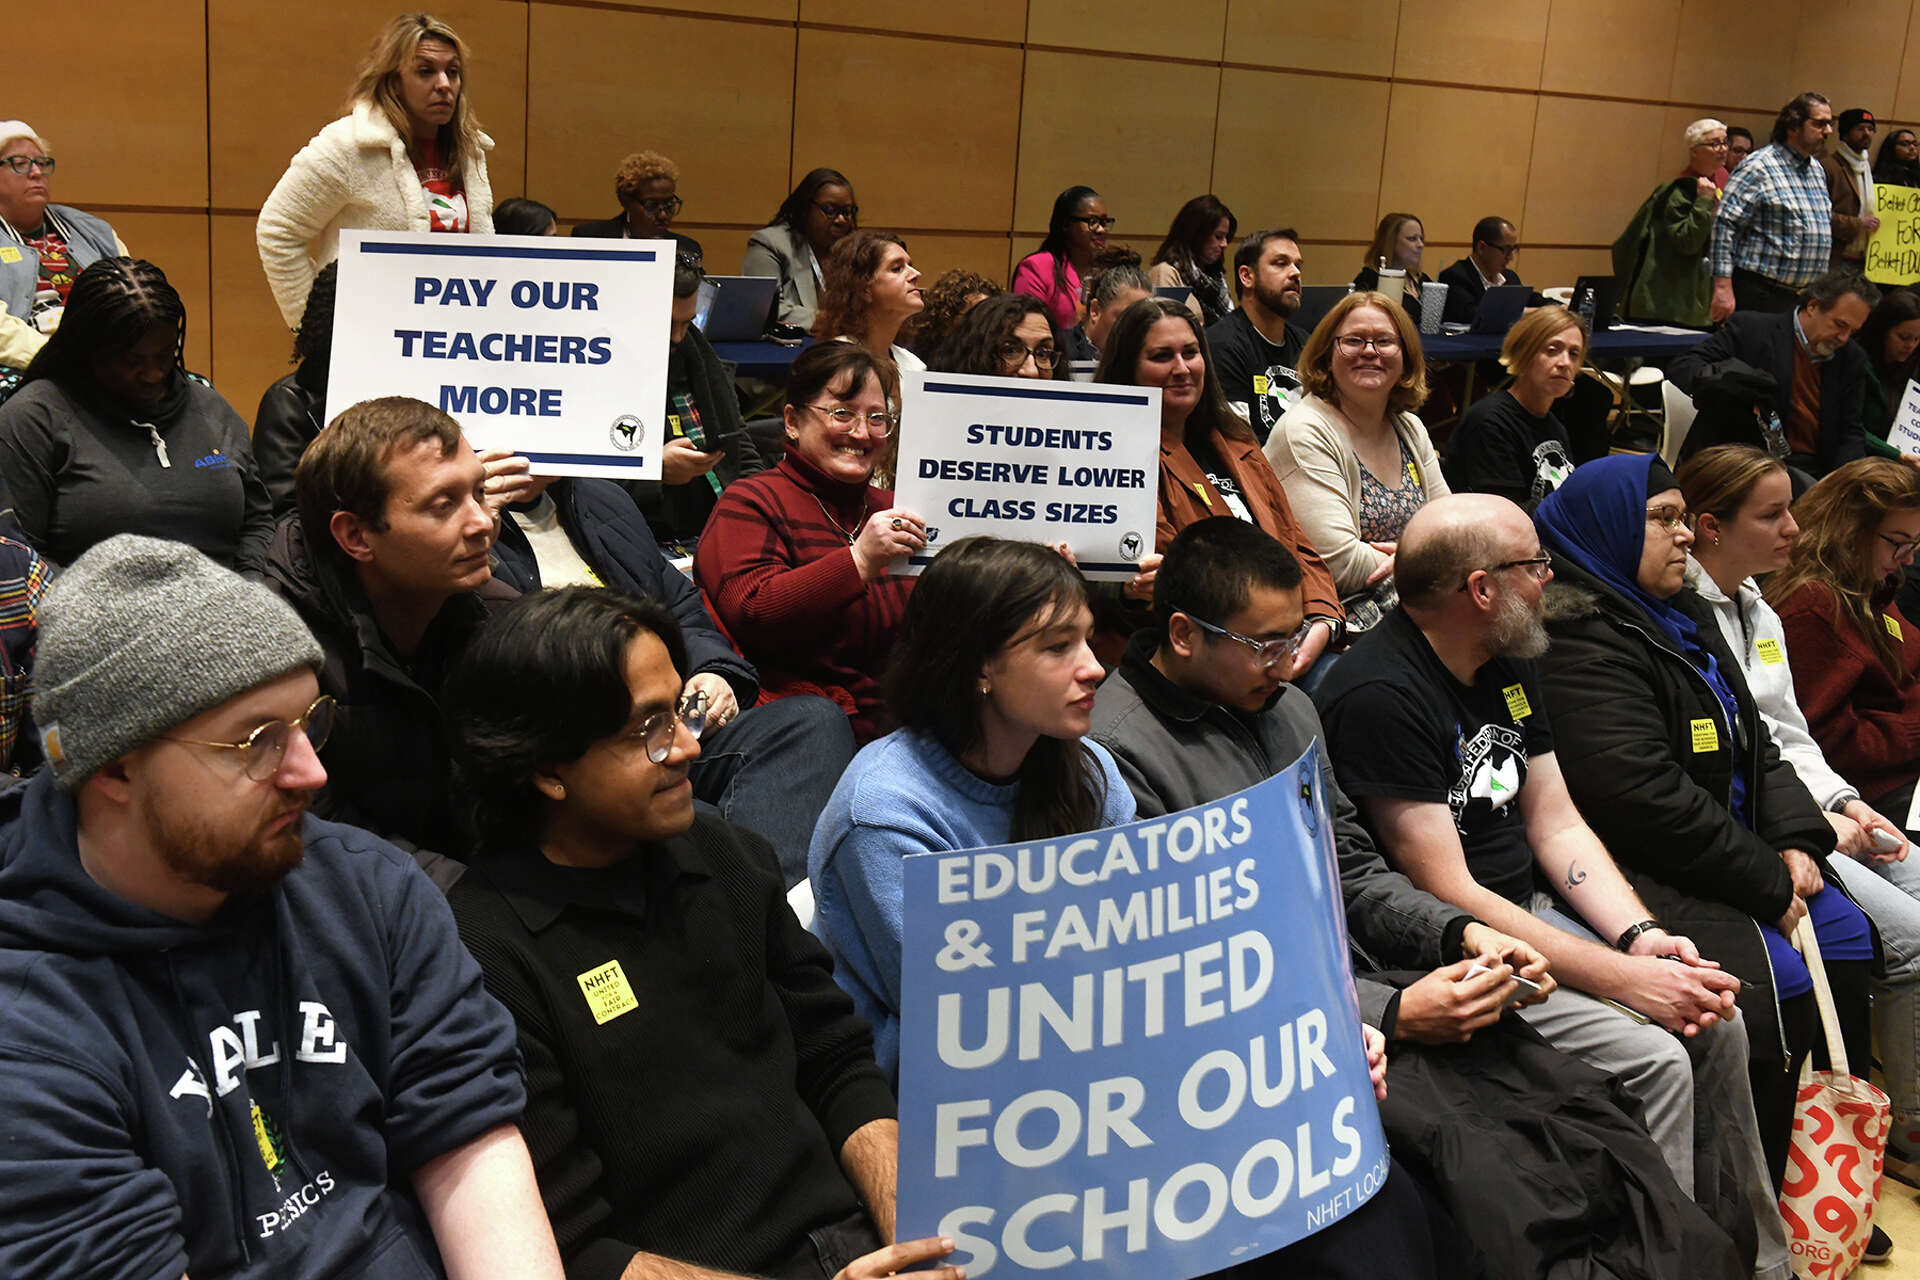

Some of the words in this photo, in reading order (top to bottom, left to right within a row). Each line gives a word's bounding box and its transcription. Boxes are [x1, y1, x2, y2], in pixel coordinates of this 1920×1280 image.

[414, 276, 498, 307] PAY
[511, 280, 600, 311] OUR
[394, 329, 612, 365] TEACHERS
[439, 385, 563, 417] MORE
[966, 423, 1113, 451] STUDENTS
[918, 458, 1049, 485] DESERVE
[1057, 466, 1146, 489] LOWER
[948, 498, 1036, 521] CLASS
[1045, 502, 1118, 524] SIZES
[1693, 722, 1713, 732] NHFT
[938, 797, 1252, 904] EDUCATORS
[935, 918, 995, 972] &
[1011, 857, 1260, 963] FAMILIES
[584, 966, 619, 991] NHFT
[936, 929, 1275, 1069] UNITED
[169, 1000, 347, 1119] YALE
[934, 1075, 1153, 1178] FOR
[1177, 1008, 1337, 1130] OUR
[256, 1169, 336, 1238] PSICS
[936, 1095, 1362, 1279] SCHOOLS
[1307, 1187, 1353, 1231] NHFT
[1790, 1241, 1831, 1261] ORG
